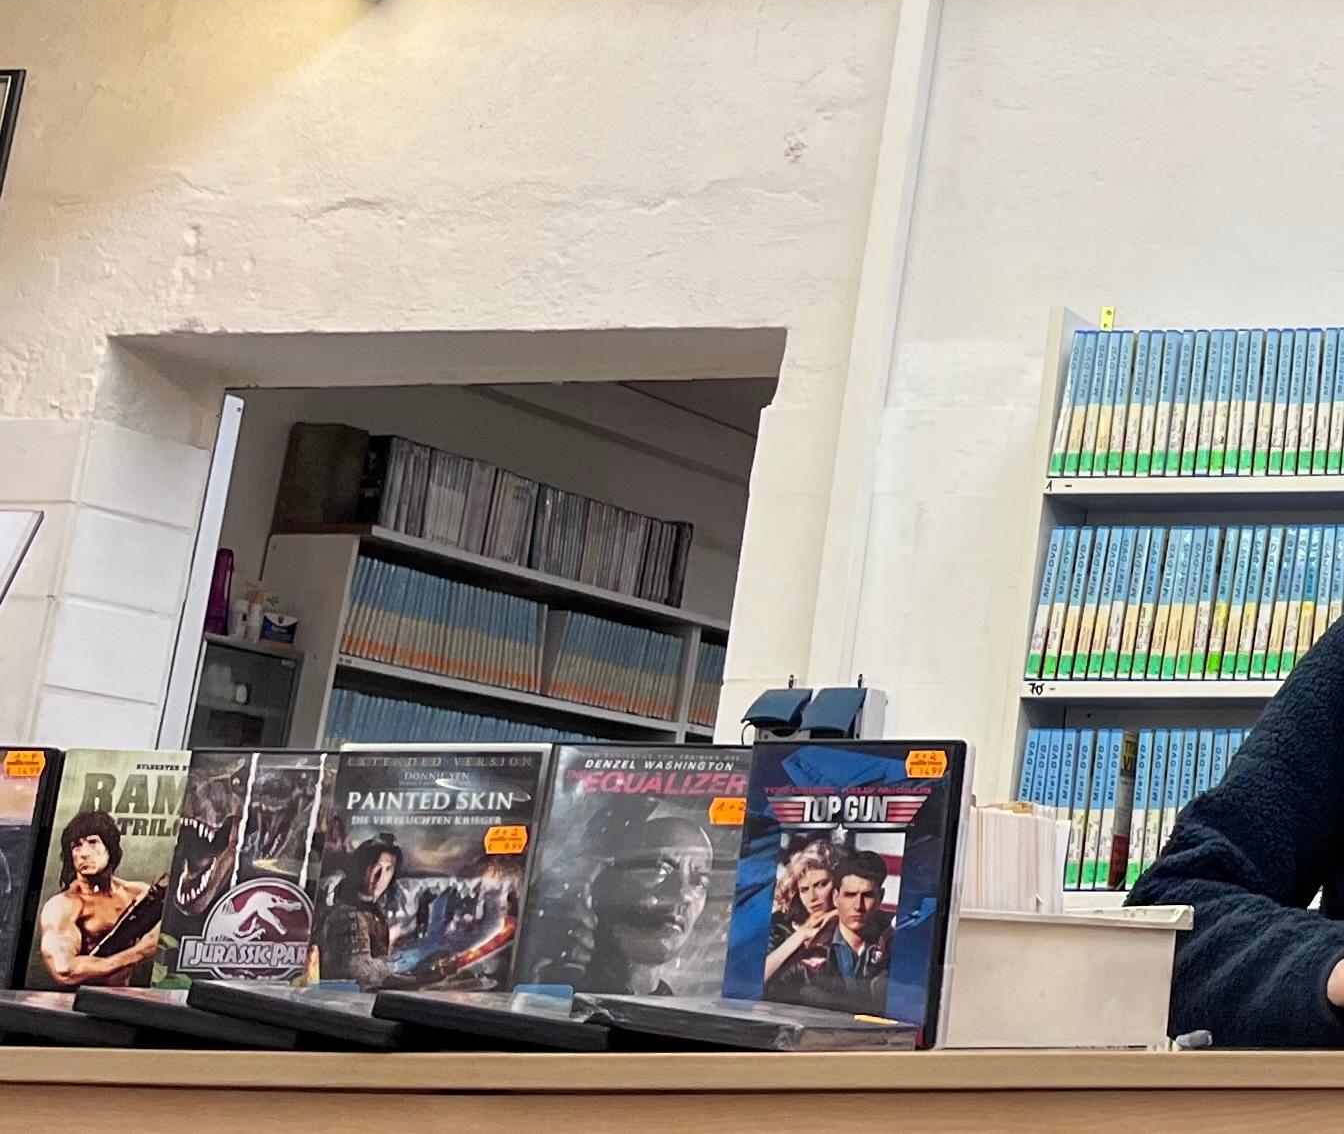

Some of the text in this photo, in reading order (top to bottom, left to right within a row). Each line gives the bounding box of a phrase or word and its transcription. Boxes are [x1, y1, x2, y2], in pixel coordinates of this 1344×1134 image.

[453, 756, 533, 766] VERSION
[584, 759, 735, 771] DENZEL WASHINGTON
[583, 770, 748, 795] EQUALIZER
[346, 791, 515, 811] PAINTED SKIN
[803, 795, 888, 823] TOP GUN
[117, 818, 181, 837] TRIL
[454, 815, 502, 825] KRIEGER
[190, 941, 270, 966] JURASSIC
